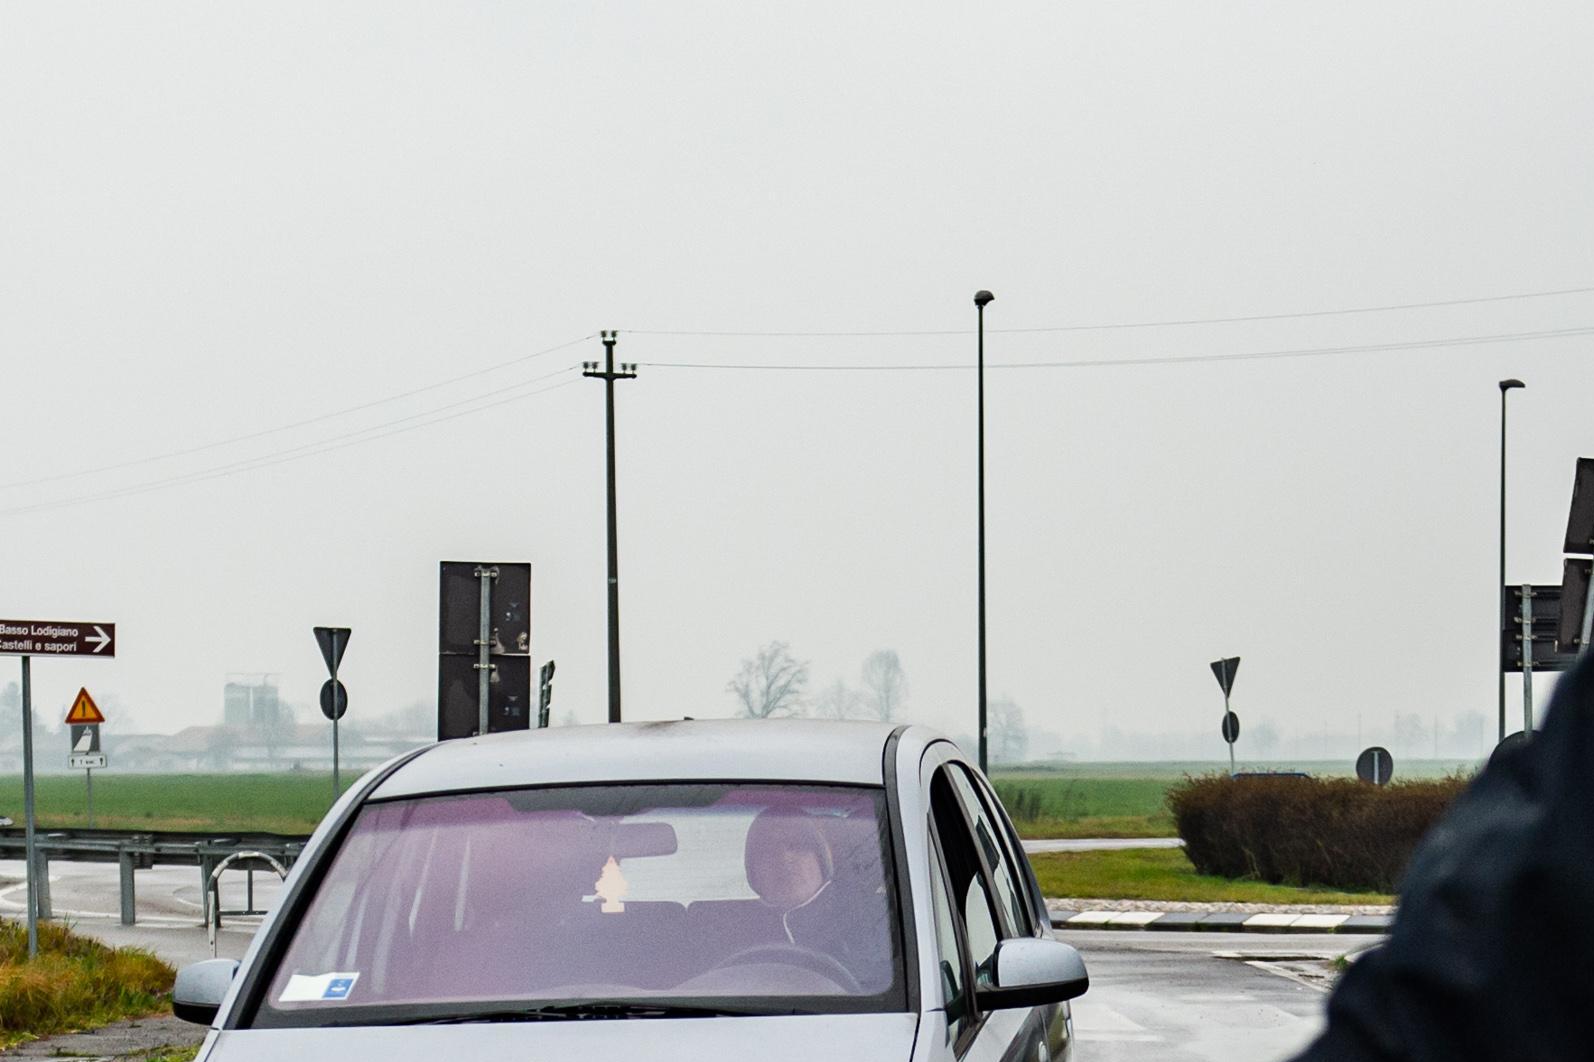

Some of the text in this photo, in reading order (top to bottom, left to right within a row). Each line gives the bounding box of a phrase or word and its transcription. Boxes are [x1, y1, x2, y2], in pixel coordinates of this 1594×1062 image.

[0, 624, 79, 638] Basso Lodigiano
[35, 643, 41, 651] e
[44, 642, 77, 653] sapori
